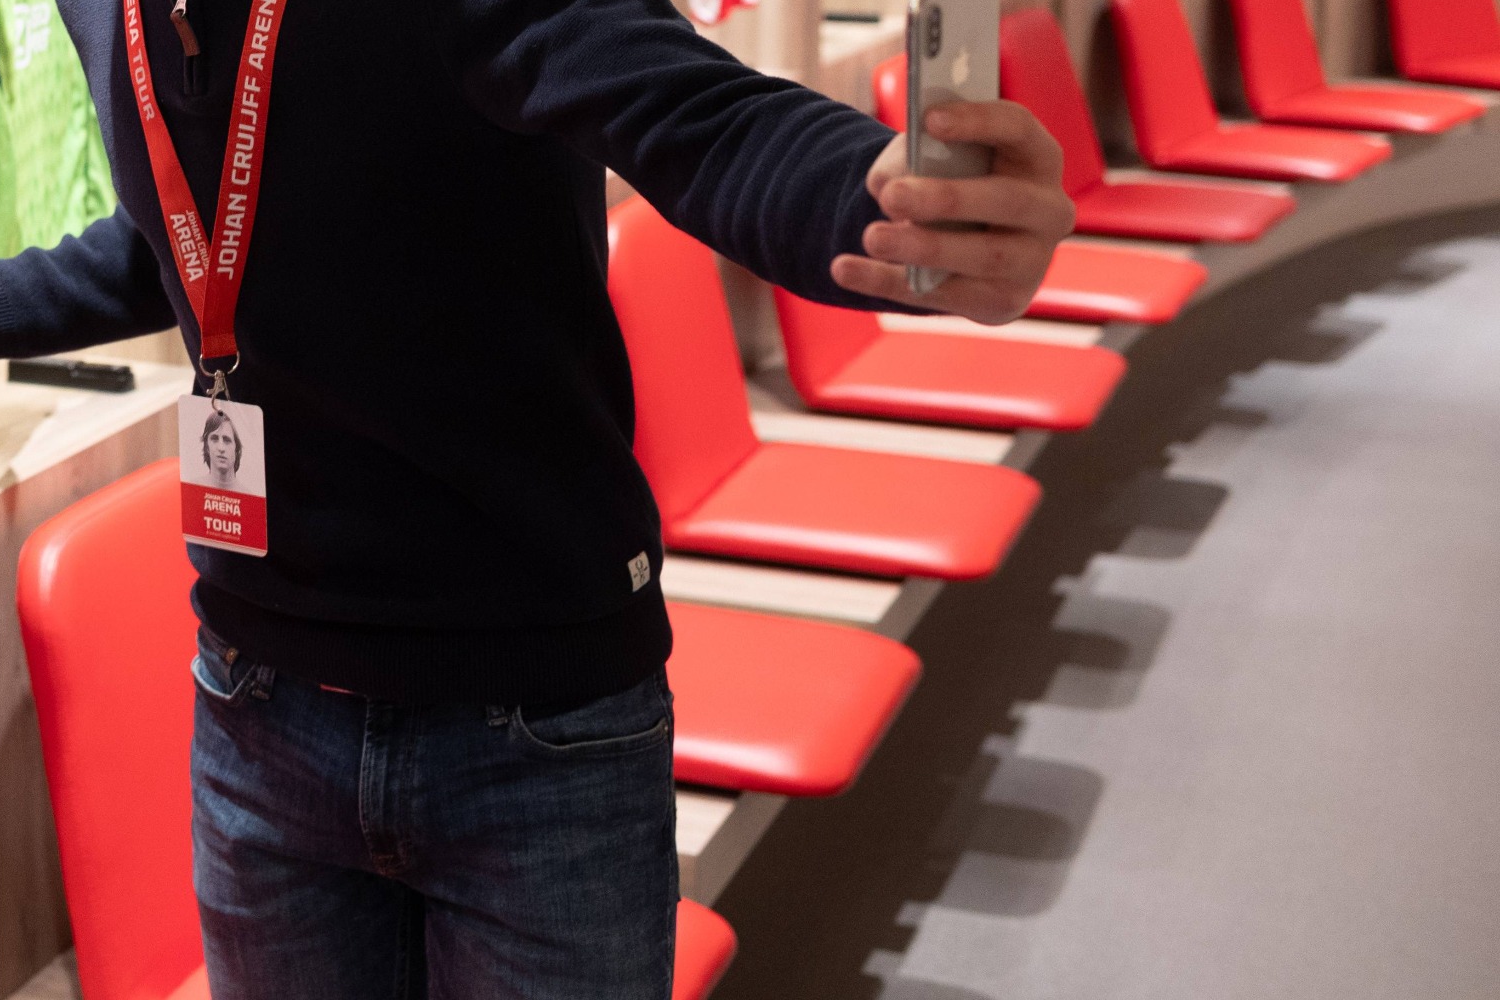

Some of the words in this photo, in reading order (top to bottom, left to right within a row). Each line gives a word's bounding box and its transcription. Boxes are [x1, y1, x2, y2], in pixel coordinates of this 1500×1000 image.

[132, 48, 155, 121] TOUR
[231, 75, 263, 186] CRUIJFF
[169, 213, 205, 283] ARENA
[217, 192, 248, 281] JOHAN
[203, 499, 241, 517] ARENA
[203, 516, 242, 536] TOUR
